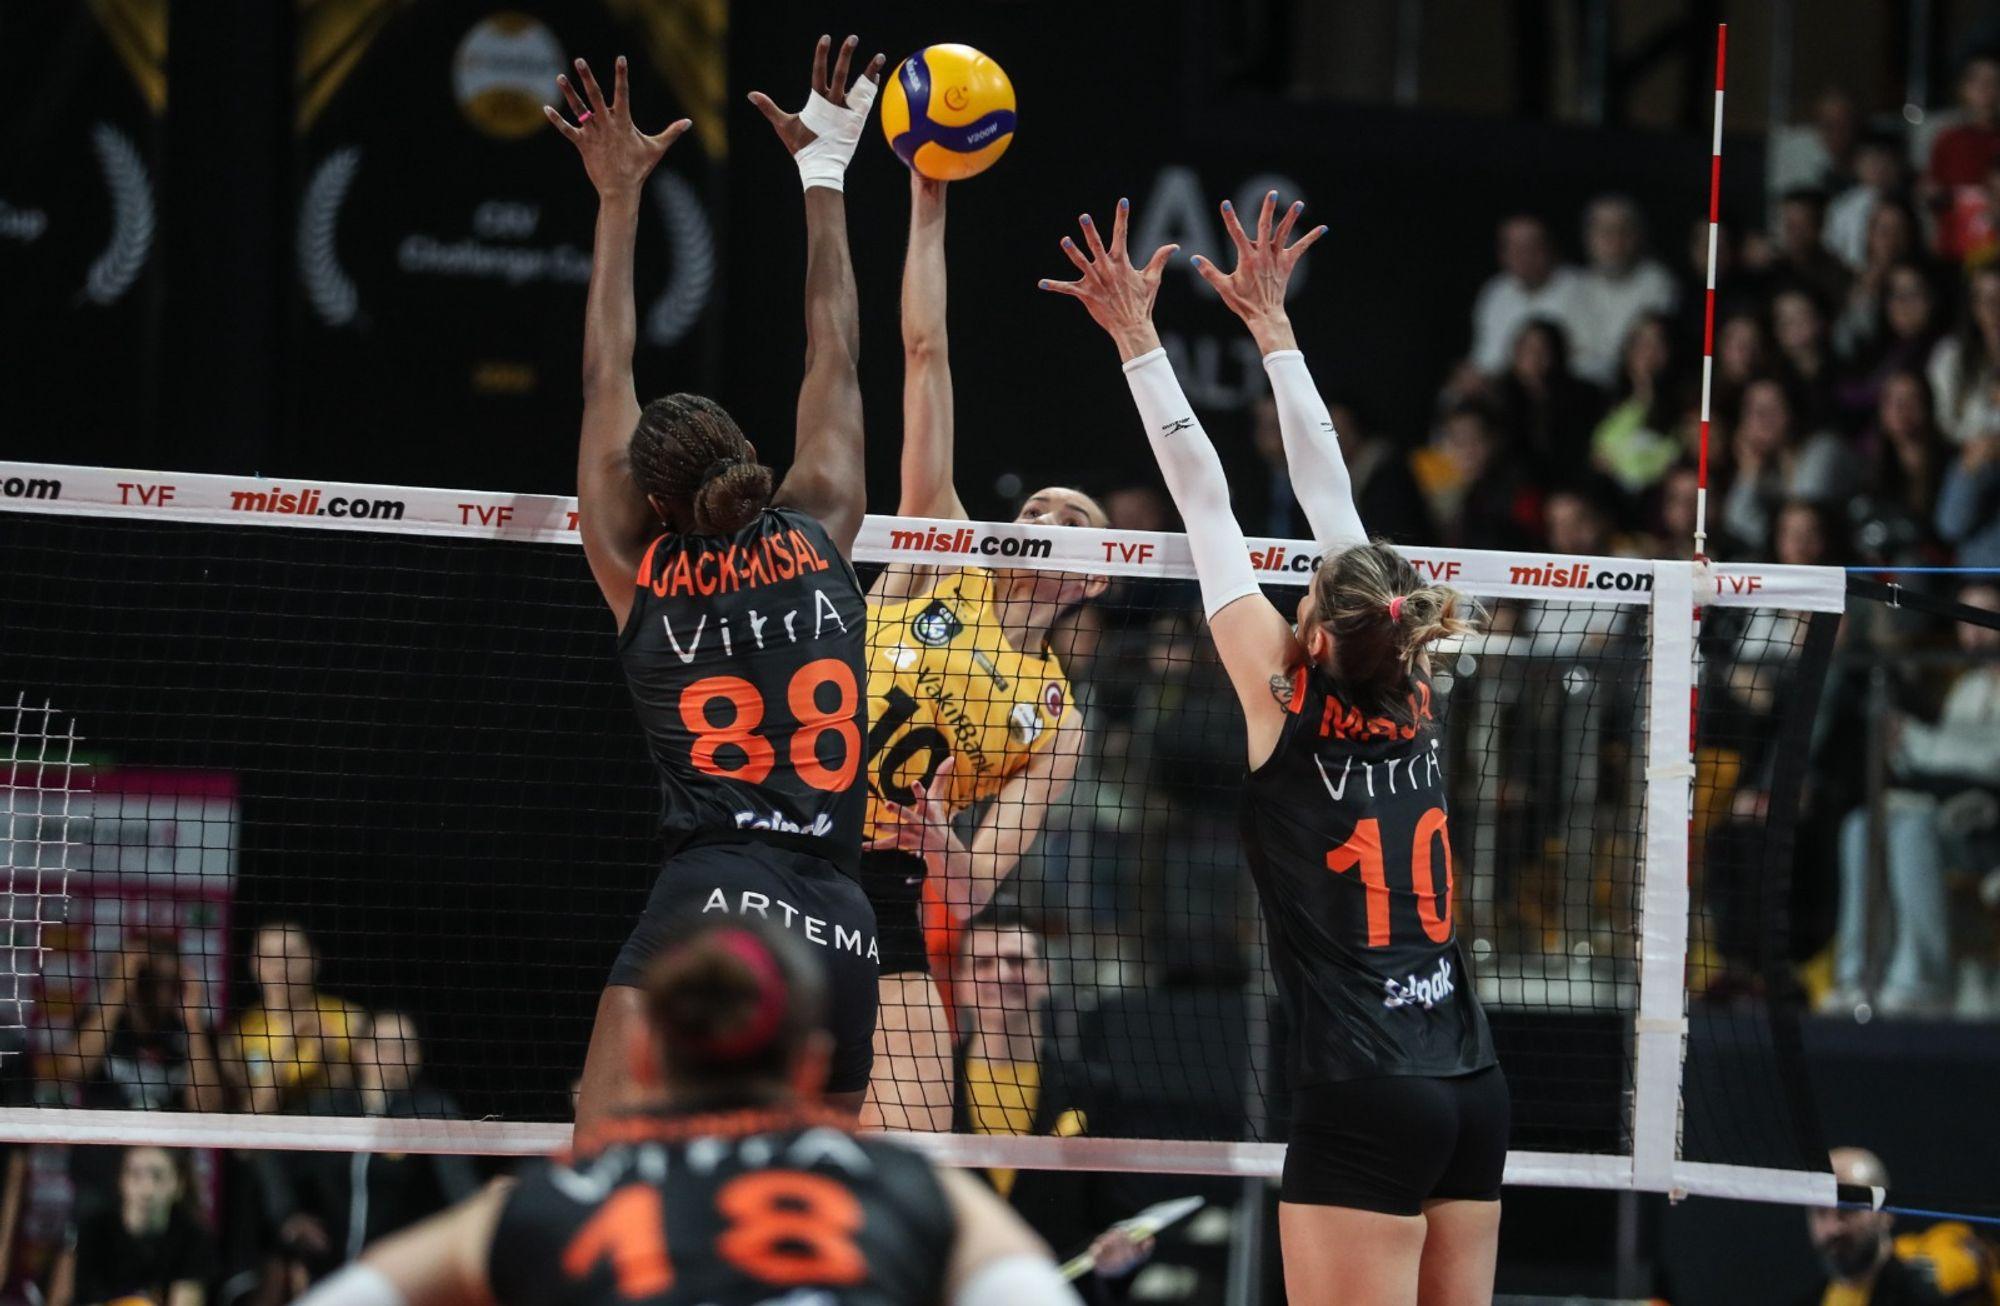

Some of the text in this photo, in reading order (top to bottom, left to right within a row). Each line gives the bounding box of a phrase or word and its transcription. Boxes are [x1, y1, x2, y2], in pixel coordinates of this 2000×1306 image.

[117, 483, 176, 507] TVF
[230, 487, 405, 520] misli.com
[457, 503, 514, 528] TVF
[890, 526, 1052, 559] misli.com
[1102, 541, 1154, 564] TVF
[1410, 559, 1461, 582] TVF
[1714, 575, 1762, 595] TVF
[678, 658, 862, 793] 88
[702, 887, 881, 965] ARTEMA
[1326, 806, 1454, 948] 10
[561, 1168, 870, 1300] 18
